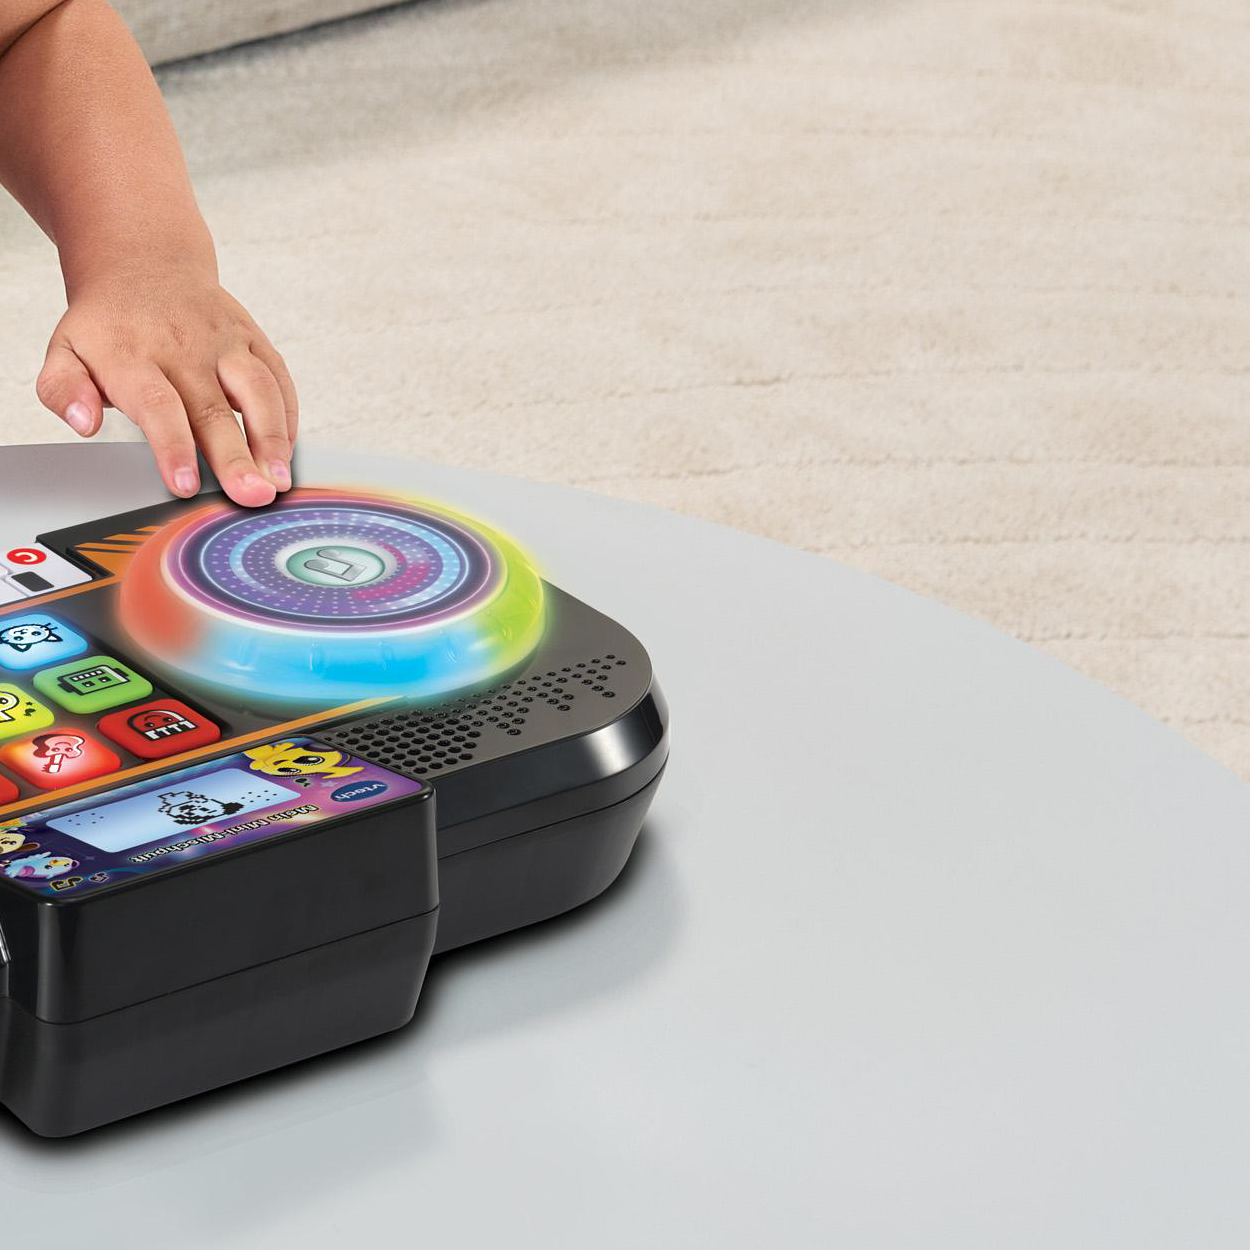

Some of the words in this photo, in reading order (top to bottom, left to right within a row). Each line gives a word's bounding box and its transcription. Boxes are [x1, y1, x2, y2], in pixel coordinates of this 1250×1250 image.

[15, 551, 39, 563] C
[334, 782, 386, 801] vtech
[268, 804, 319, 822] Mein
[129, 817, 271, 864] Mini-Mischpult
